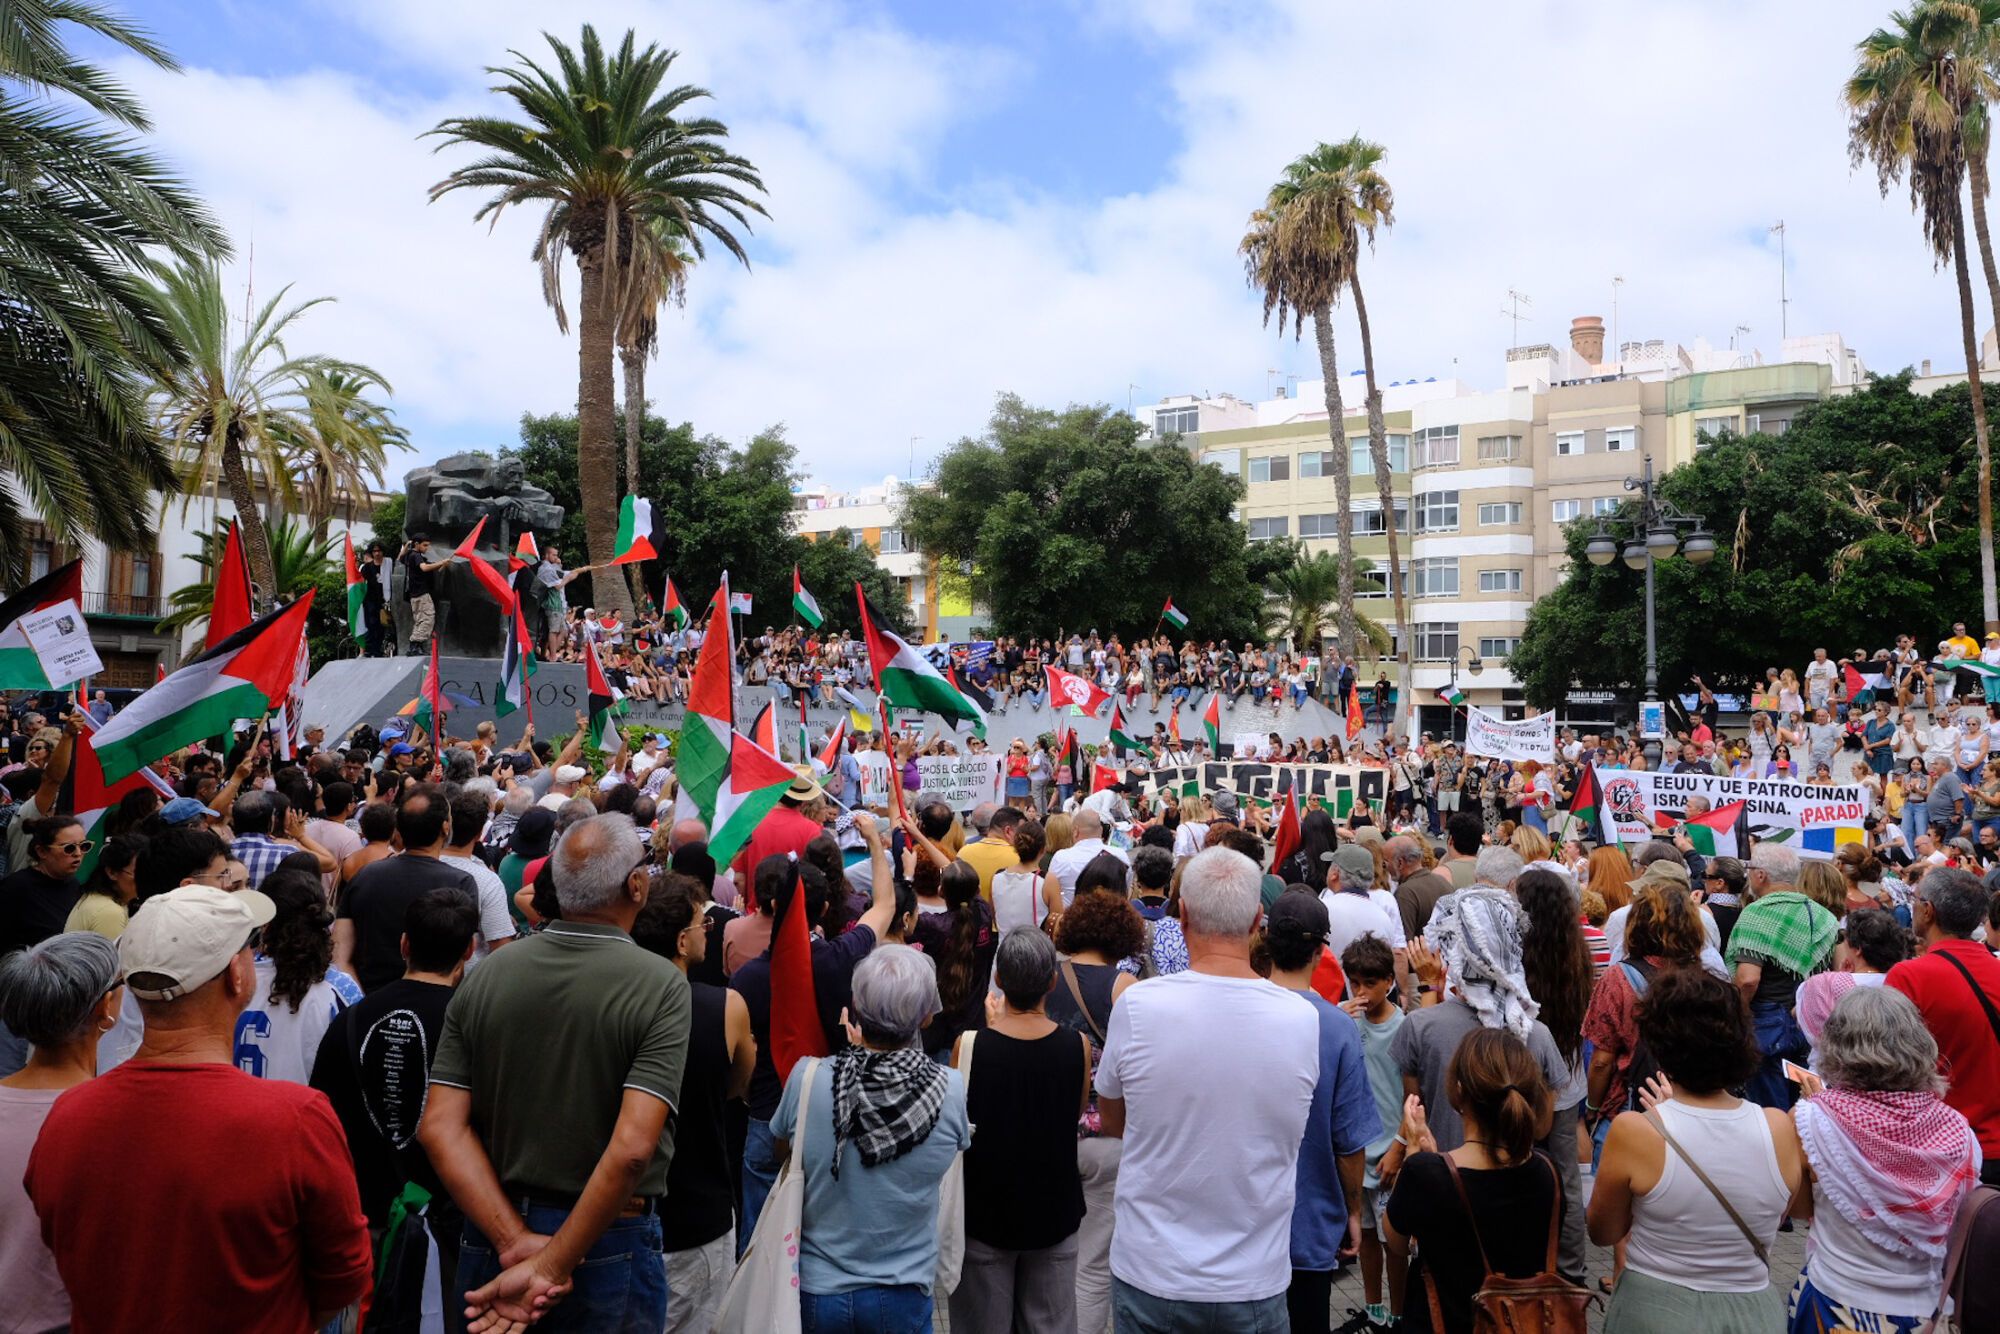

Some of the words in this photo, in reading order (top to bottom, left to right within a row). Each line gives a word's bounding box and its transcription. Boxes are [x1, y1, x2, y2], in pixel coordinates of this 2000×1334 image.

[919, 763, 941, 775] EMOS
[1653, 776, 1698, 791] EEUU
[1703, 778, 1714, 792] Y
[1720, 780, 1742, 794] UE
[1748, 782, 1859, 802] PATROCINAN
[1653, 793, 1688, 808] ISRA
[1714, 797, 1791, 816] ASSINA.
[1800, 803, 1864, 828] ¡PARAD!
